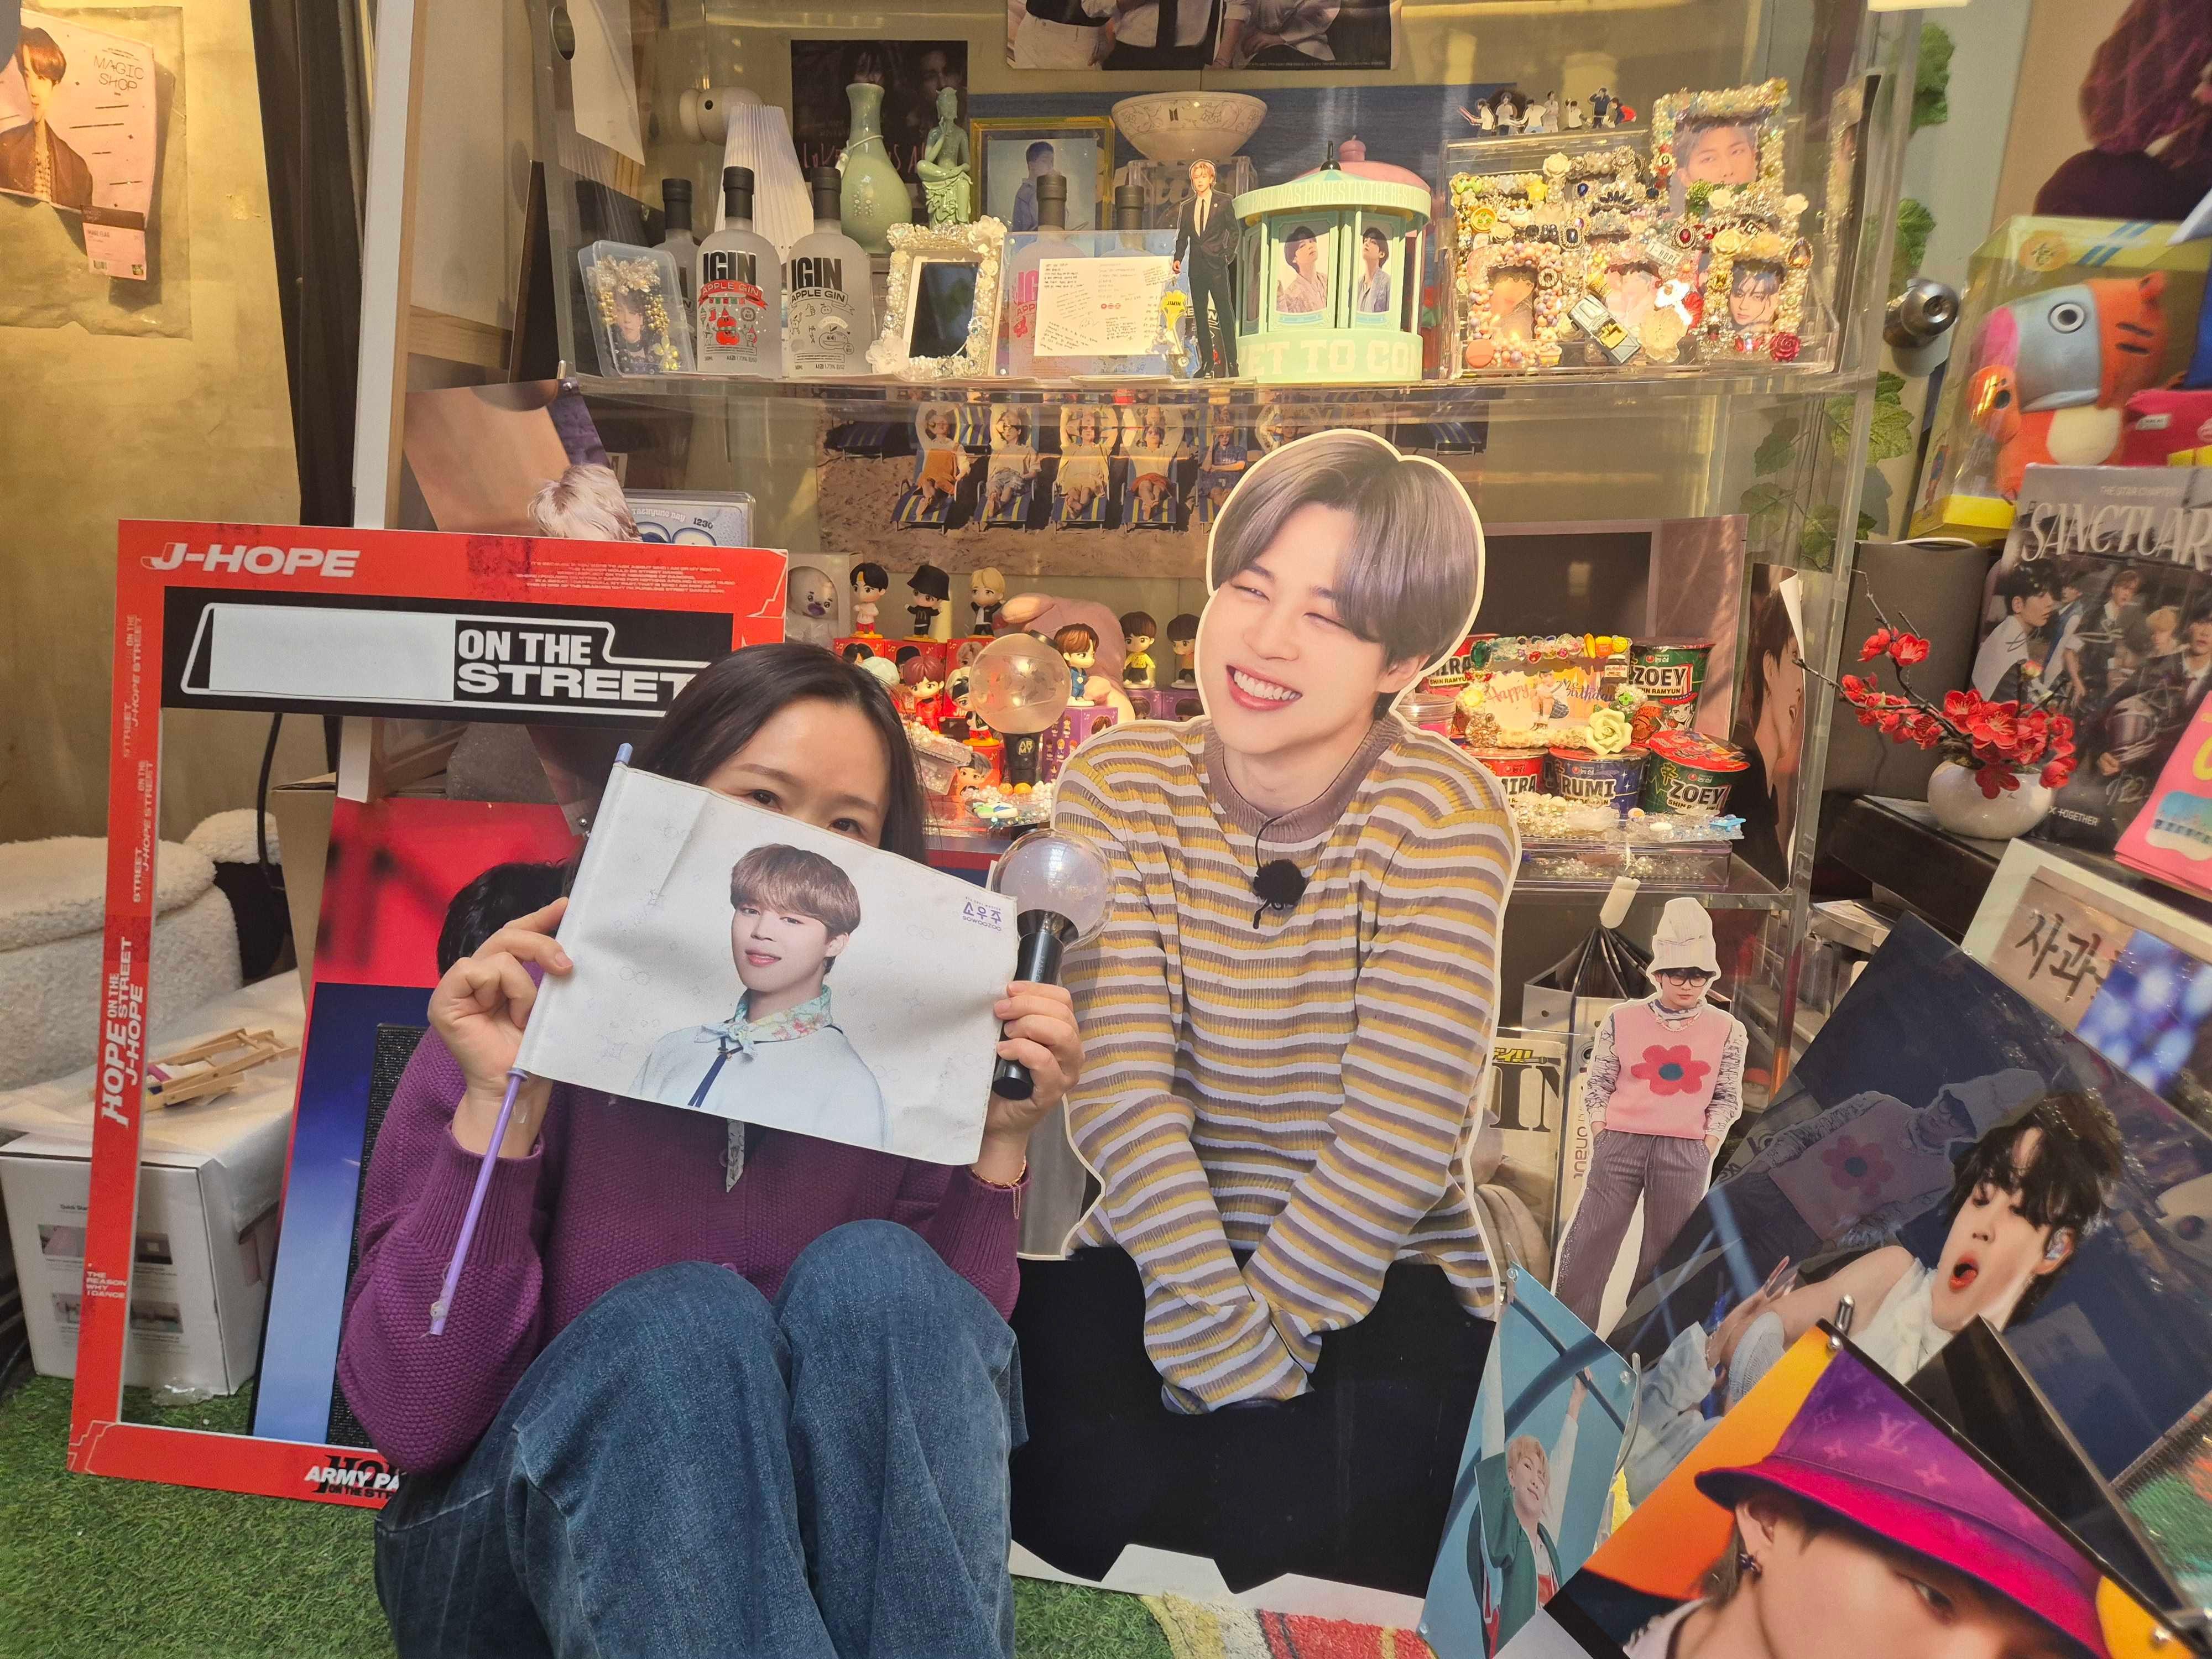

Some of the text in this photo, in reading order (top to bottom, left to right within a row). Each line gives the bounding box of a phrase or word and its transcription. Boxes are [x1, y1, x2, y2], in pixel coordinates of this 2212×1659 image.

[93, 55, 144, 80] MAGIC
[98, 72, 138, 91] SHOP
[1305, 180, 1366, 205] HONESTLY
[703, 250, 757, 286] IGIN
[791, 257, 843, 292] IGIN
[702, 281, 760, 297] APPLE GIN
[791, 289, 846, 304] APPLE GIN
[1301, 339, 1356, 374] TO
[693, 517, 714, 529] 1230
[140, 542, 361, 578] J-HOPE
[458, 629, 592, 666] ON THE
[457, 662, 697, 702] STREET
[1634, 667, 1687, 687] ZOEY
[1484, 684, 1529, 703] Happy
[1561, 775, 1615, 798] RUMI
[1668, 780, 1726, 805] ZOEY
[962, 915, 1001, 931] SOWOOZOO
[963, 901, 1002, 924] 소우주
[2015, 912, 2121, 1003] 사과
[118, 936, 133, 1019] STREET
[107, 973, 119, 1019] ON THE
[125, 983, 144, 1086] J-HOPE
[101, 1020, 130, 1129] HOPE
[86, 1277, 127, 1286] REASON
[304, 1465, 400, 1491] ARMY PA
